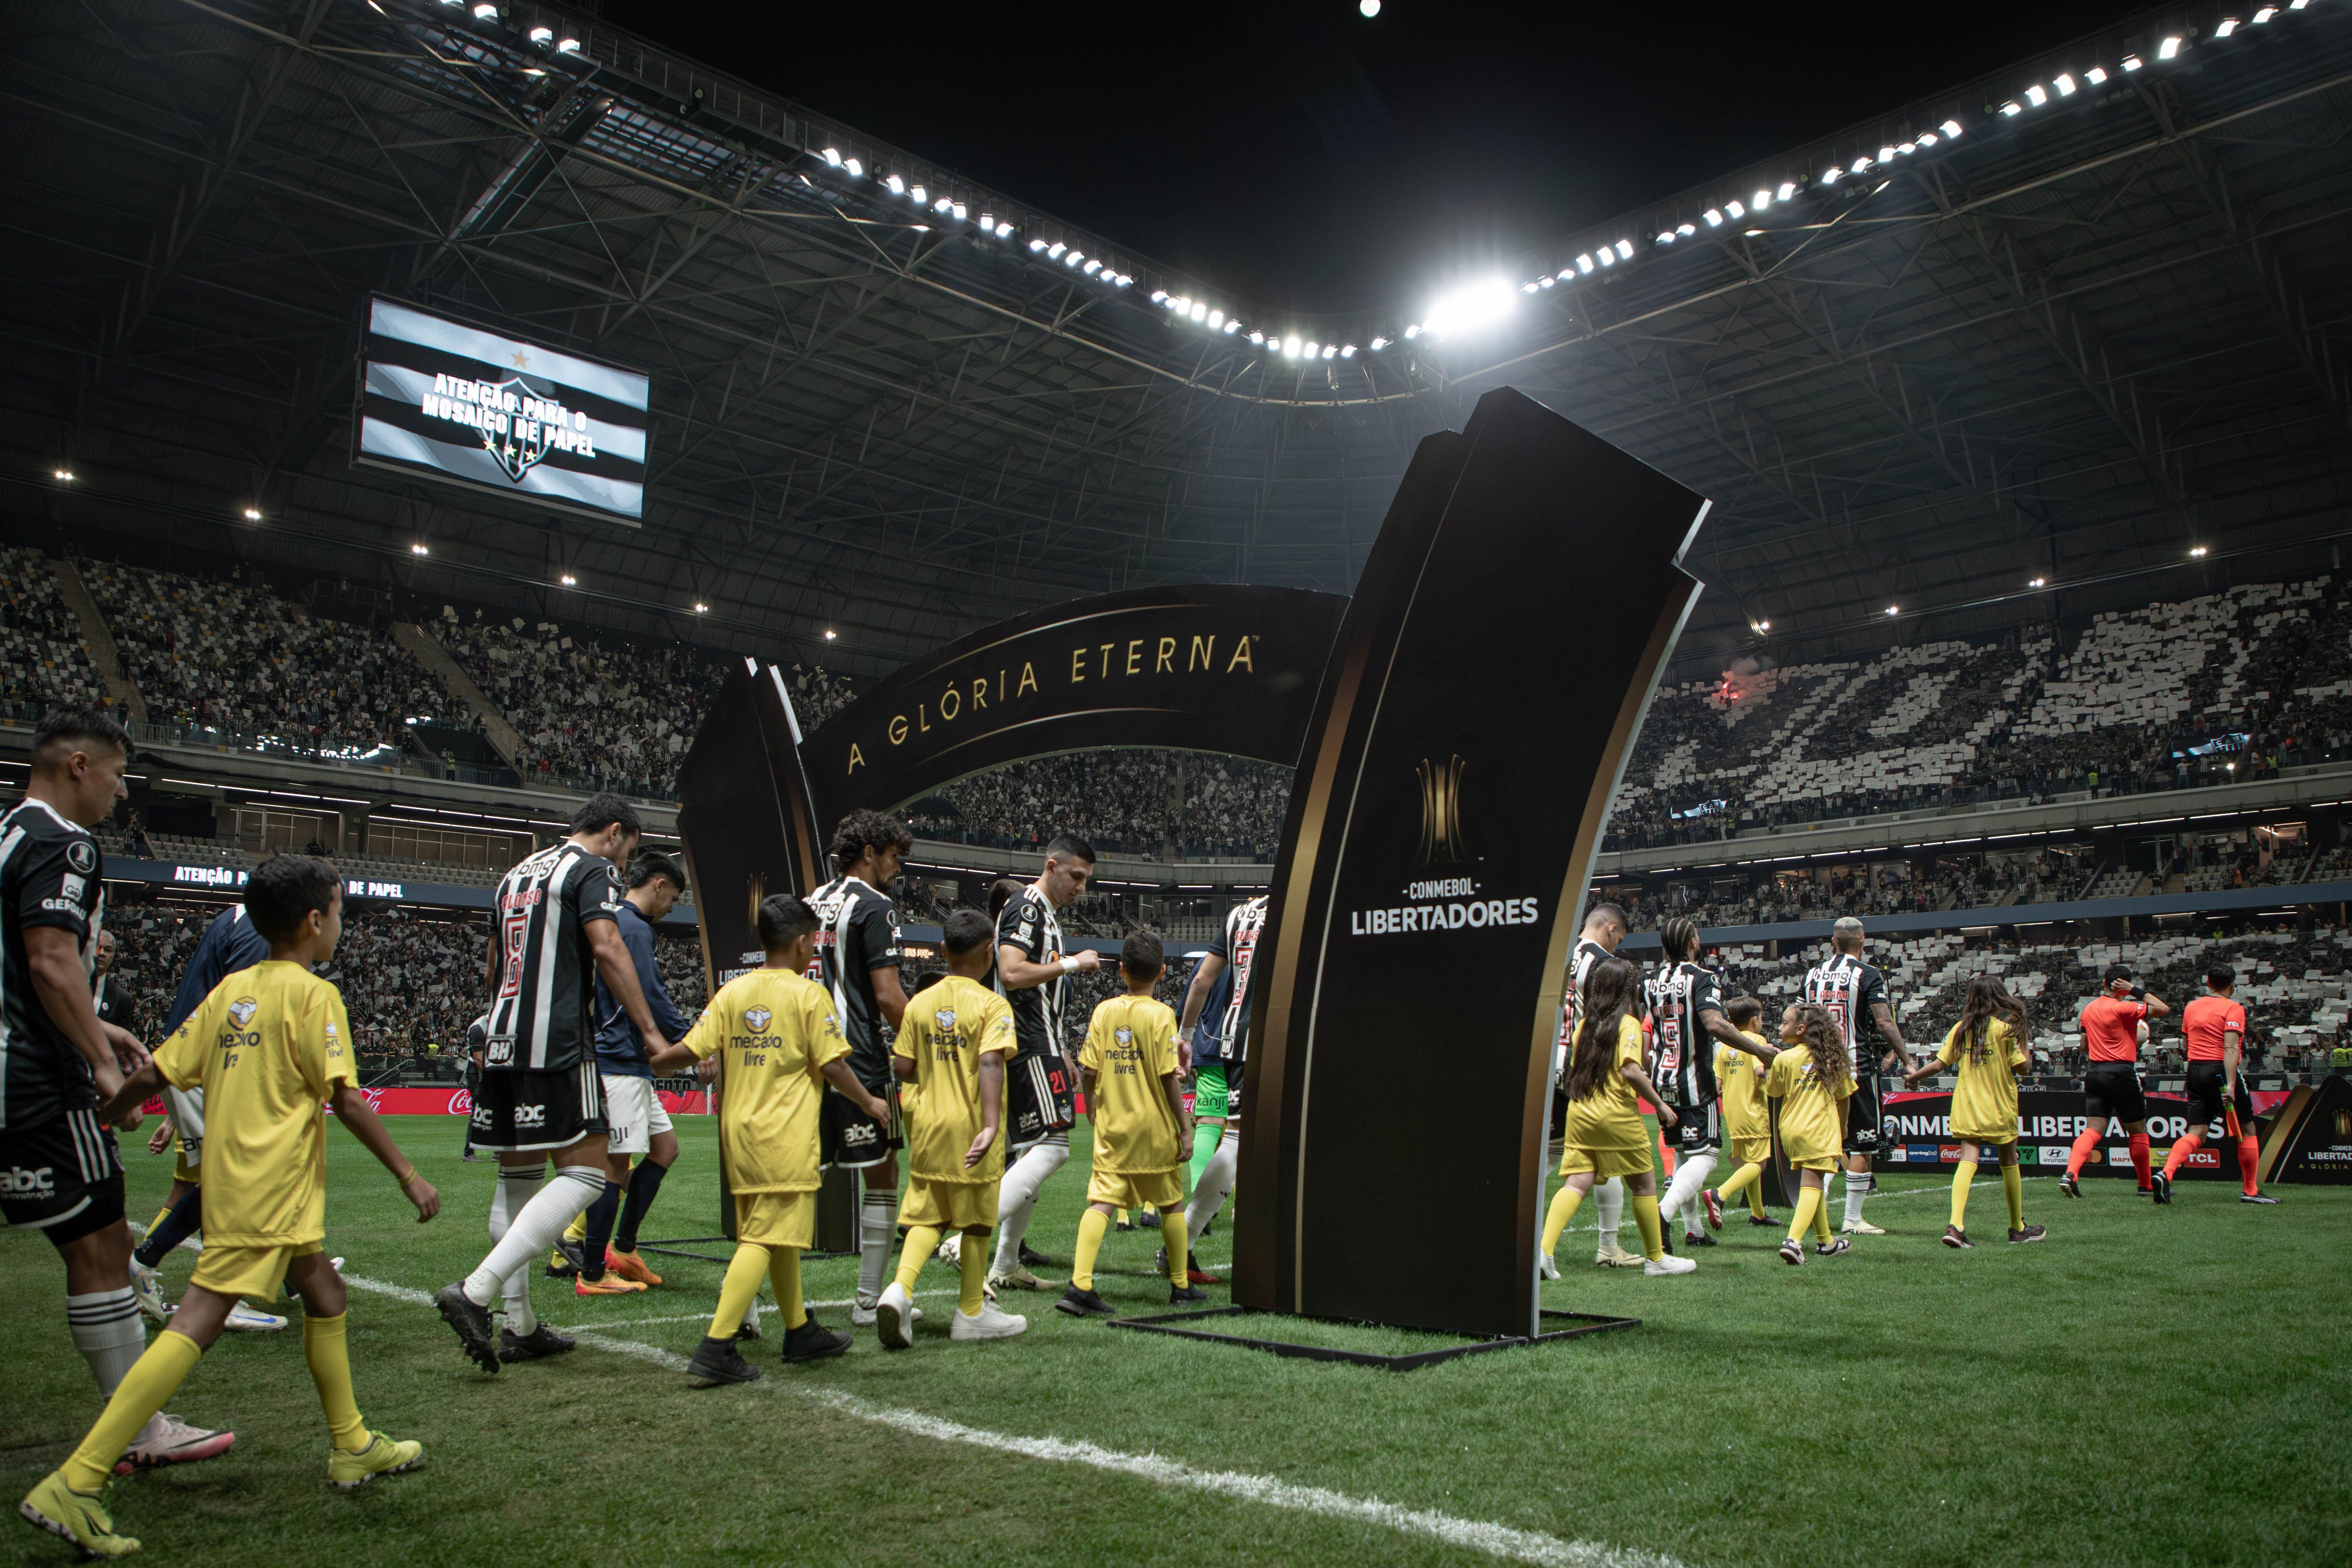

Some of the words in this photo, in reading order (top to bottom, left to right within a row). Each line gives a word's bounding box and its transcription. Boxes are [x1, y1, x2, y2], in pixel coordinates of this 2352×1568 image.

[434, 373, 515, 413] ATENÇÃO
[523, 396, 568, 428] PARA
[575, 411, 587, 432] O
[422, 393, 508, 434] MOSAICO
[515, 418, 538, 443] DE
[544, 425, 595, 458] PAPEL
[848, 743, 865, 776] A
[888, 662, 1039, 746] GLÓRIA
[175, 866, 232, 886] ATENÇÃO
[518, 860, 553, 878] bmg
[349, 880, 364, 894] DE
[368, 882, 403, 898] PAPEL
[1352, 897, 1539, 935] LIBERTADORES
[1235, 929, 1260, 942] FUCHS
[743, 951, 766, 964] CONMEBO
[1232, 946, 1253, 1006] 3
[1822, 970, 1849, 983] bmg
[1660, 982, 1684, 995] bmg
[1820, 990, 1849, 1000] ARANA
[488, 1041, 511, 1060] BH
[1660, 1019, 1678, 1068] 5
[936, 1047, 959, 1061] livre
[1114, 1062, 1135, 1074] livre
[1049, 1070, 1067, 1094] 21
[1197, 1097, 1224, 1110] kanji
[1228, 1088, 1240, 1102] bc
[1661, 1091, 1676, 1103] BH
[473, 1103, 493, 1125] bc
[514, 1103, 545, 1122] abc
[1019, 1111, 1039, 1129] abc
[844, 1123, 876, 1142] abc
[1856, 1129, 1877, 1141] abc
[2188, 1153, 2217, 1163] TCL
[0, 1166, 54, 1191] abc
